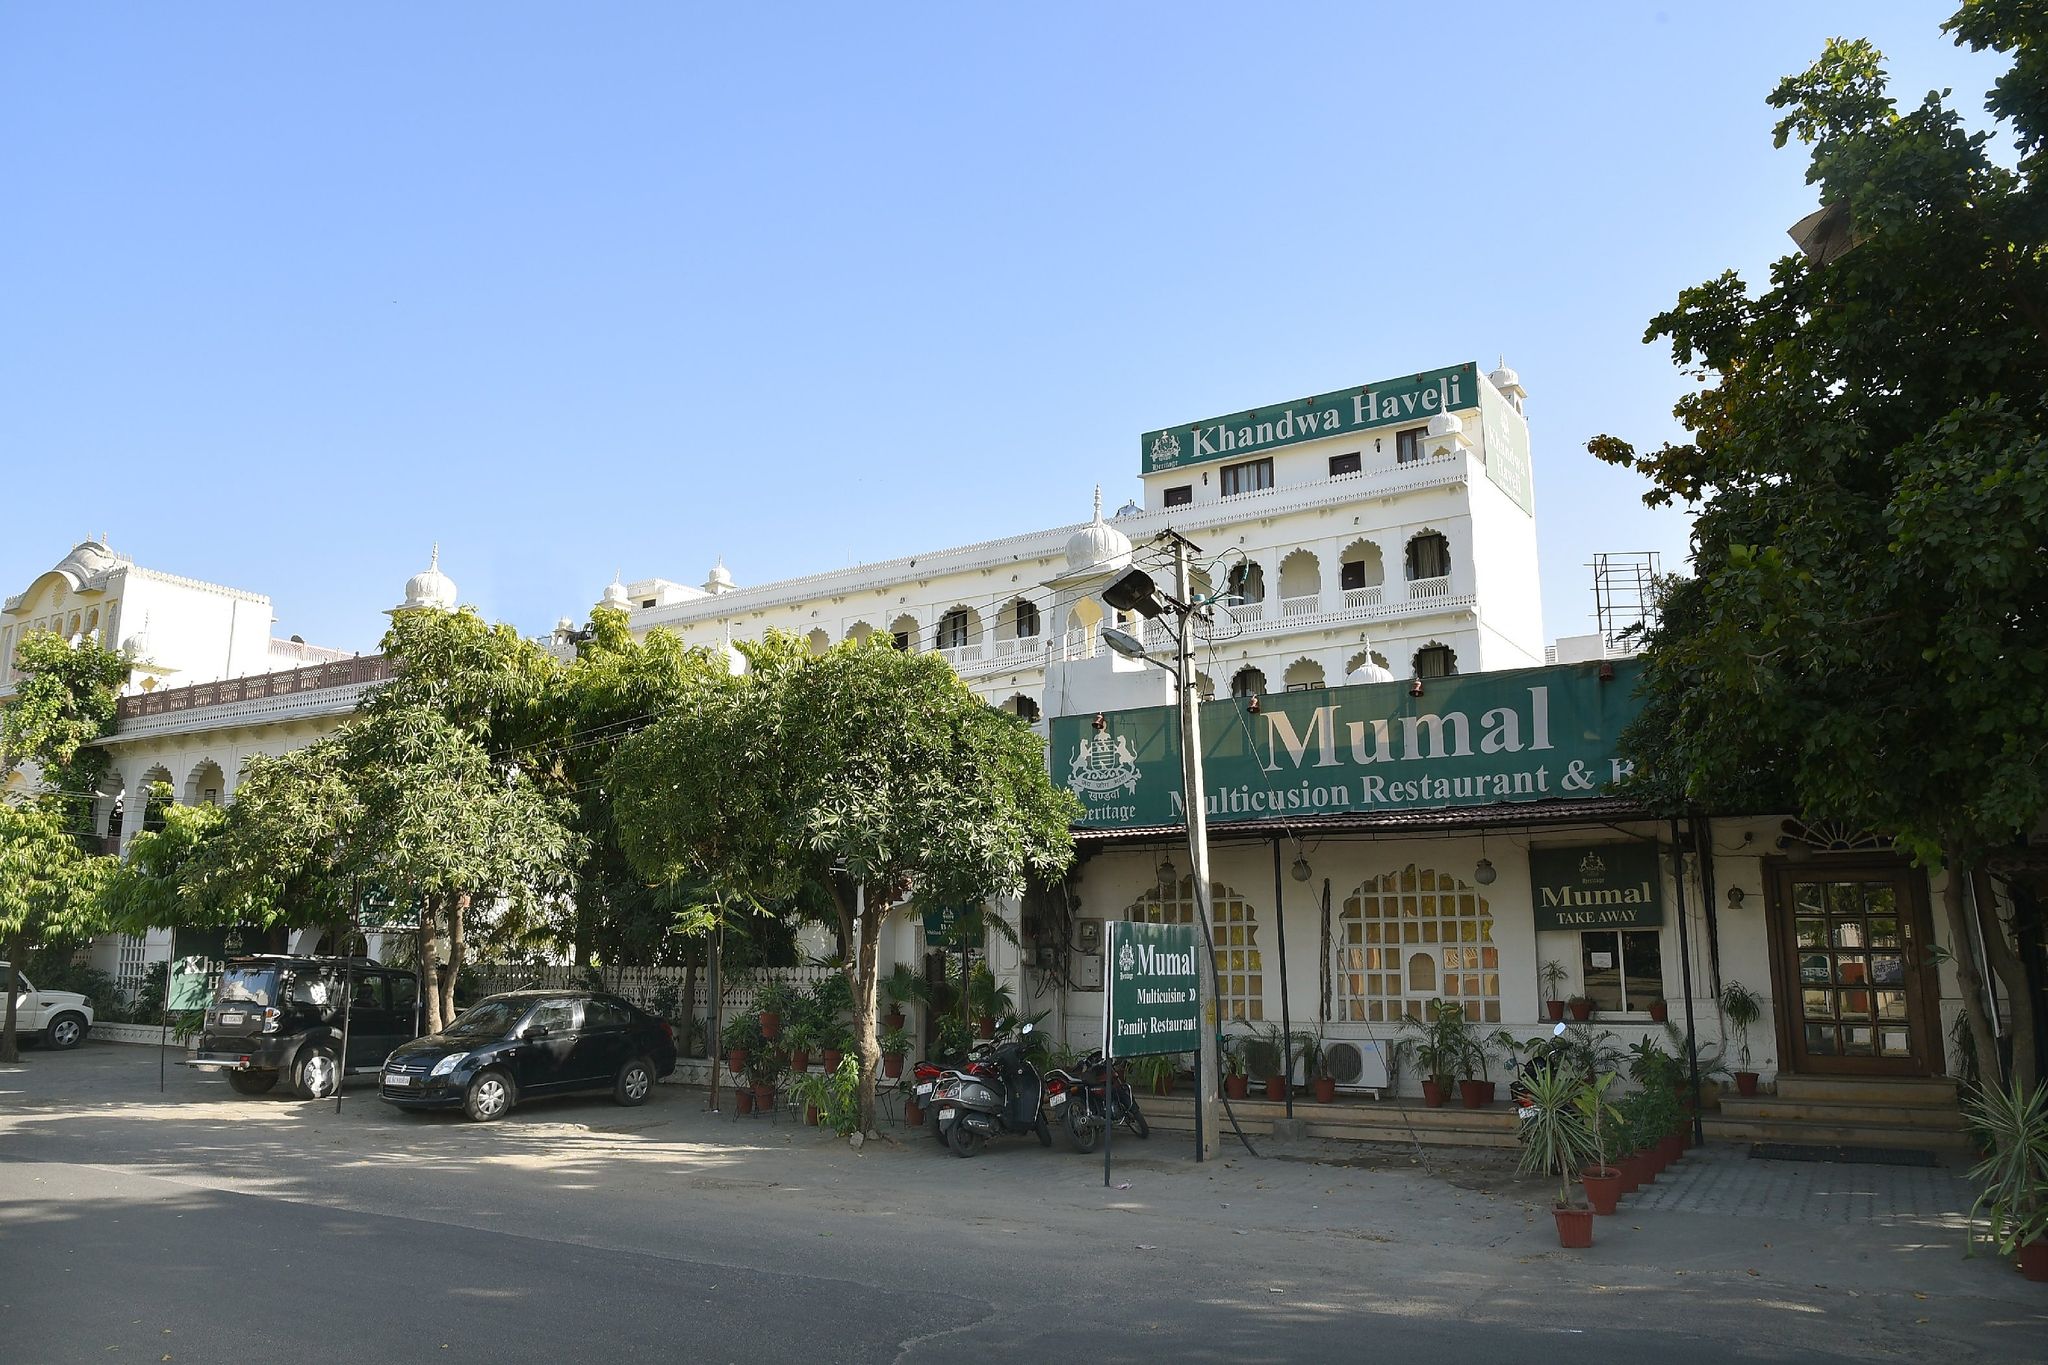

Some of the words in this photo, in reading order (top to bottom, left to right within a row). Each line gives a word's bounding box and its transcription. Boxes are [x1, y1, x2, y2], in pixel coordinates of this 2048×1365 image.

[1190, 408, 1342, 458] Khandwa
[1351, 374, 1463, 425] Haveli
[1259, 686, 1555, 773] Mumal
[1167, 779, 1350, 817] Multicusion
[1360, 764, 1550, 805] Restaurant
[1560, 759, 1596, 792] &
[1539, 881, 1653, 908] Mumal
[1556, 911, 1596, 925] TAKE
[1598, 909, 1638, 923] AWAY
[1136, 943, 1197, 977] Mumal
[1136, 987, 1187, 1006] Multicuisine
[1117, 1018, 1149, 1039] Family
[1150, 1016, 1198, 1034] Restaurant
